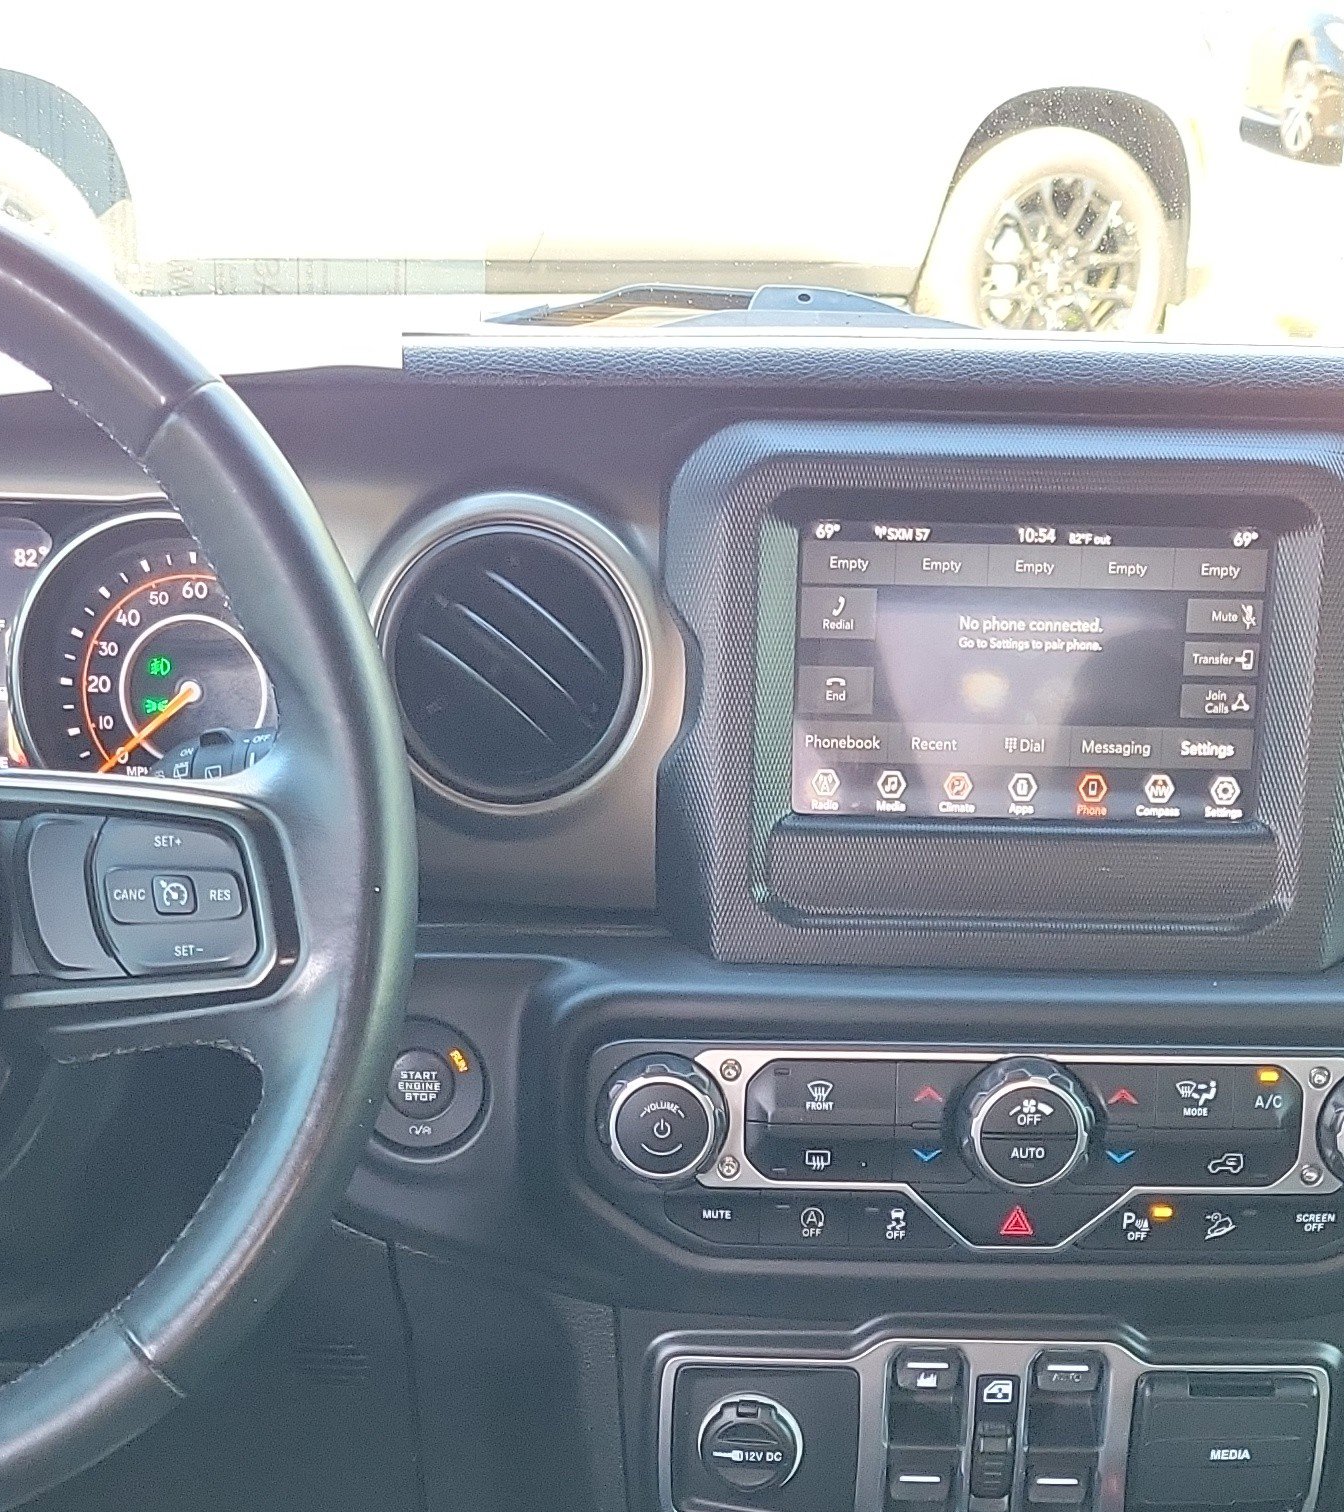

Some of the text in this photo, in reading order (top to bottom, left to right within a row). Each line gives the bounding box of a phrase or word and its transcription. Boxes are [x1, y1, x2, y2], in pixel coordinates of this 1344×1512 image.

[887, 528, 913, 541] SXM
[915, 528, 931, 541] 57
[1017, 527, 1056, 544] 10:54
[1094, 534, 1112, 546] out
[829, 555, 869, 572] Empty
[922, 557, 962, 574] Empty
[1015, 559, 1054, 576] Empty
[1108, 561, 1148, 578] Empty
[1201, 563, 1241, 580] Empty
[182, 581, 208, 599] 60
[149, 591, 170, 606] 50
[116, 609, 141, 627] 40
[1211, 610, 1239, 622] Mute
[822, 618, 854, 631] Redial
[959, 615, 1103, 633] No phone connected.
[98, 641, 119, 657] 30
[958, 637, 1103, 653] Go to Settings to pair phone.
[1193, 653, 1233, 666] Transfer
[87, 675, 111, 693] 20
[826, 690, 846, 701] End
[1205, 690, 1227, 701] Join
[1205, 702, 1229, 714] Calls
[98, 715, 114, 730] 10
[805, 734, 880, 750] Phonebook
[911, 736, 958, 751] Recent
[1020, 738, 1045, 752] Dial
[1082, 740, 1151, 757] Messaging
[1180, 740, 1235, 759] Settings
[811, 800, 839, 811] Radio
[876, 800, 906, 812] Media
[938, 801, 975, 813] Climate
[1008, 802, 1034, 815] Apps
[1076, 804, 1107, 816] Phone
[1135, 805, 1180, 818] Compass
[1204, 805, 1243, 819] Settings
[113, 888, 146, 901] CANC
[209, 888, 231, 901] RES
[400, 1070, 438, 1080] START
[398, 1081, 441, 1091] ENGINE
[404, 1092, 437, 1102] STOP
[1254, 1093, 1282, 1111] A/C
[644, 1100, 680, 1114] VOLUME
[806, 1100, 834, 1111] FRONT
[1183, 1107, 1208, 1117] MODE
[1017, 1113, 1042, 1127] OFF
[1010, 1146, 1046, 1160] AUTO
[702, 1209, 732, 1221] MUTE
[1295, 1213, 1335, 1223] SCREEN
[802, 1228, 823, 1238] OFF
[1304, 1223, 1324, 1232] OFF
[885, 1230, 906, 1240] OFF
[1127, 1231, 1147, 1241] OFF
[744, 1451, 783, 1462] 12V DC
[1210, 1449, 1251, 1460] MEDIA
